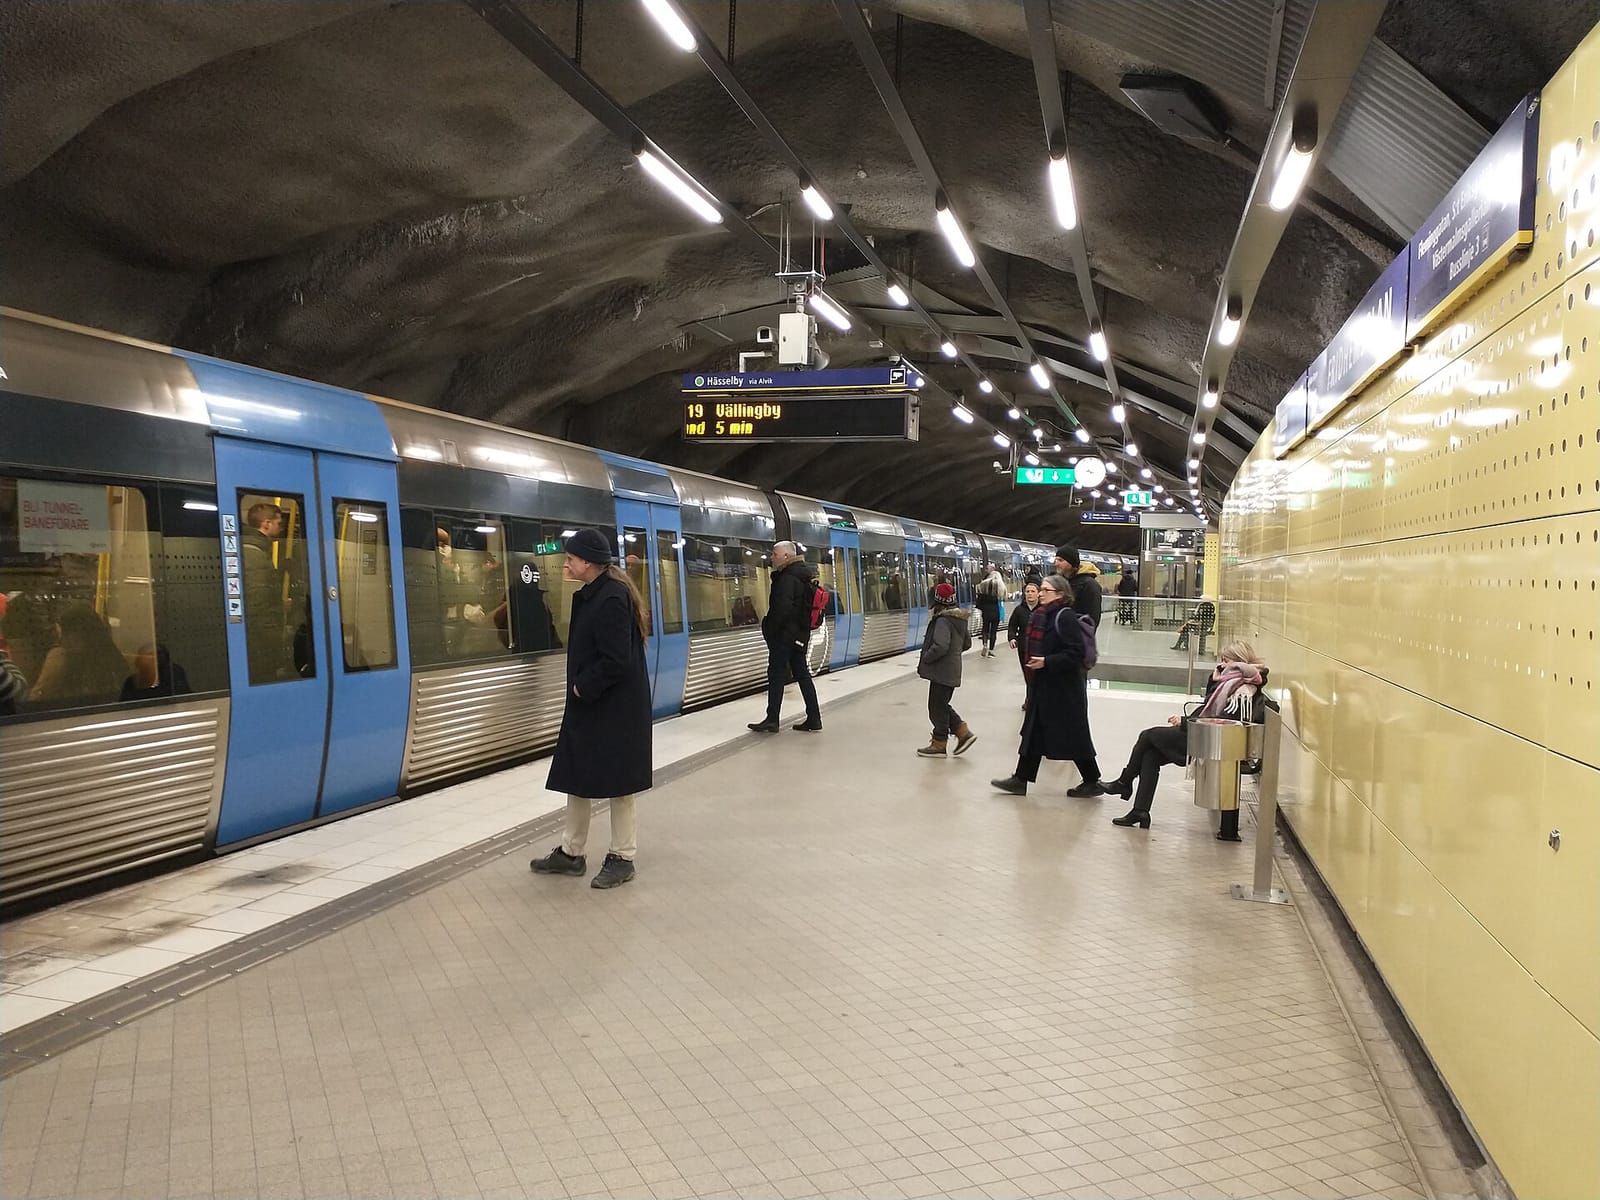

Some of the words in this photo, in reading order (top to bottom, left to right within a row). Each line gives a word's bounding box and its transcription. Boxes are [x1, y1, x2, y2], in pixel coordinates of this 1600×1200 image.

[1449, 242, 1475, 281] Busslinje
[1475, 235, 1480, 257] 3
[707, 376, 744, 387] Hässelby
[758, 377, 773, 385] Alvik
[687, 403, 704, 418] 19
[715, 403, 781, 420] Vällingby
[715, 420, 725, 435] 5
[729, 420, 753, 435] min
[23, 500, 39, 513] BLI
